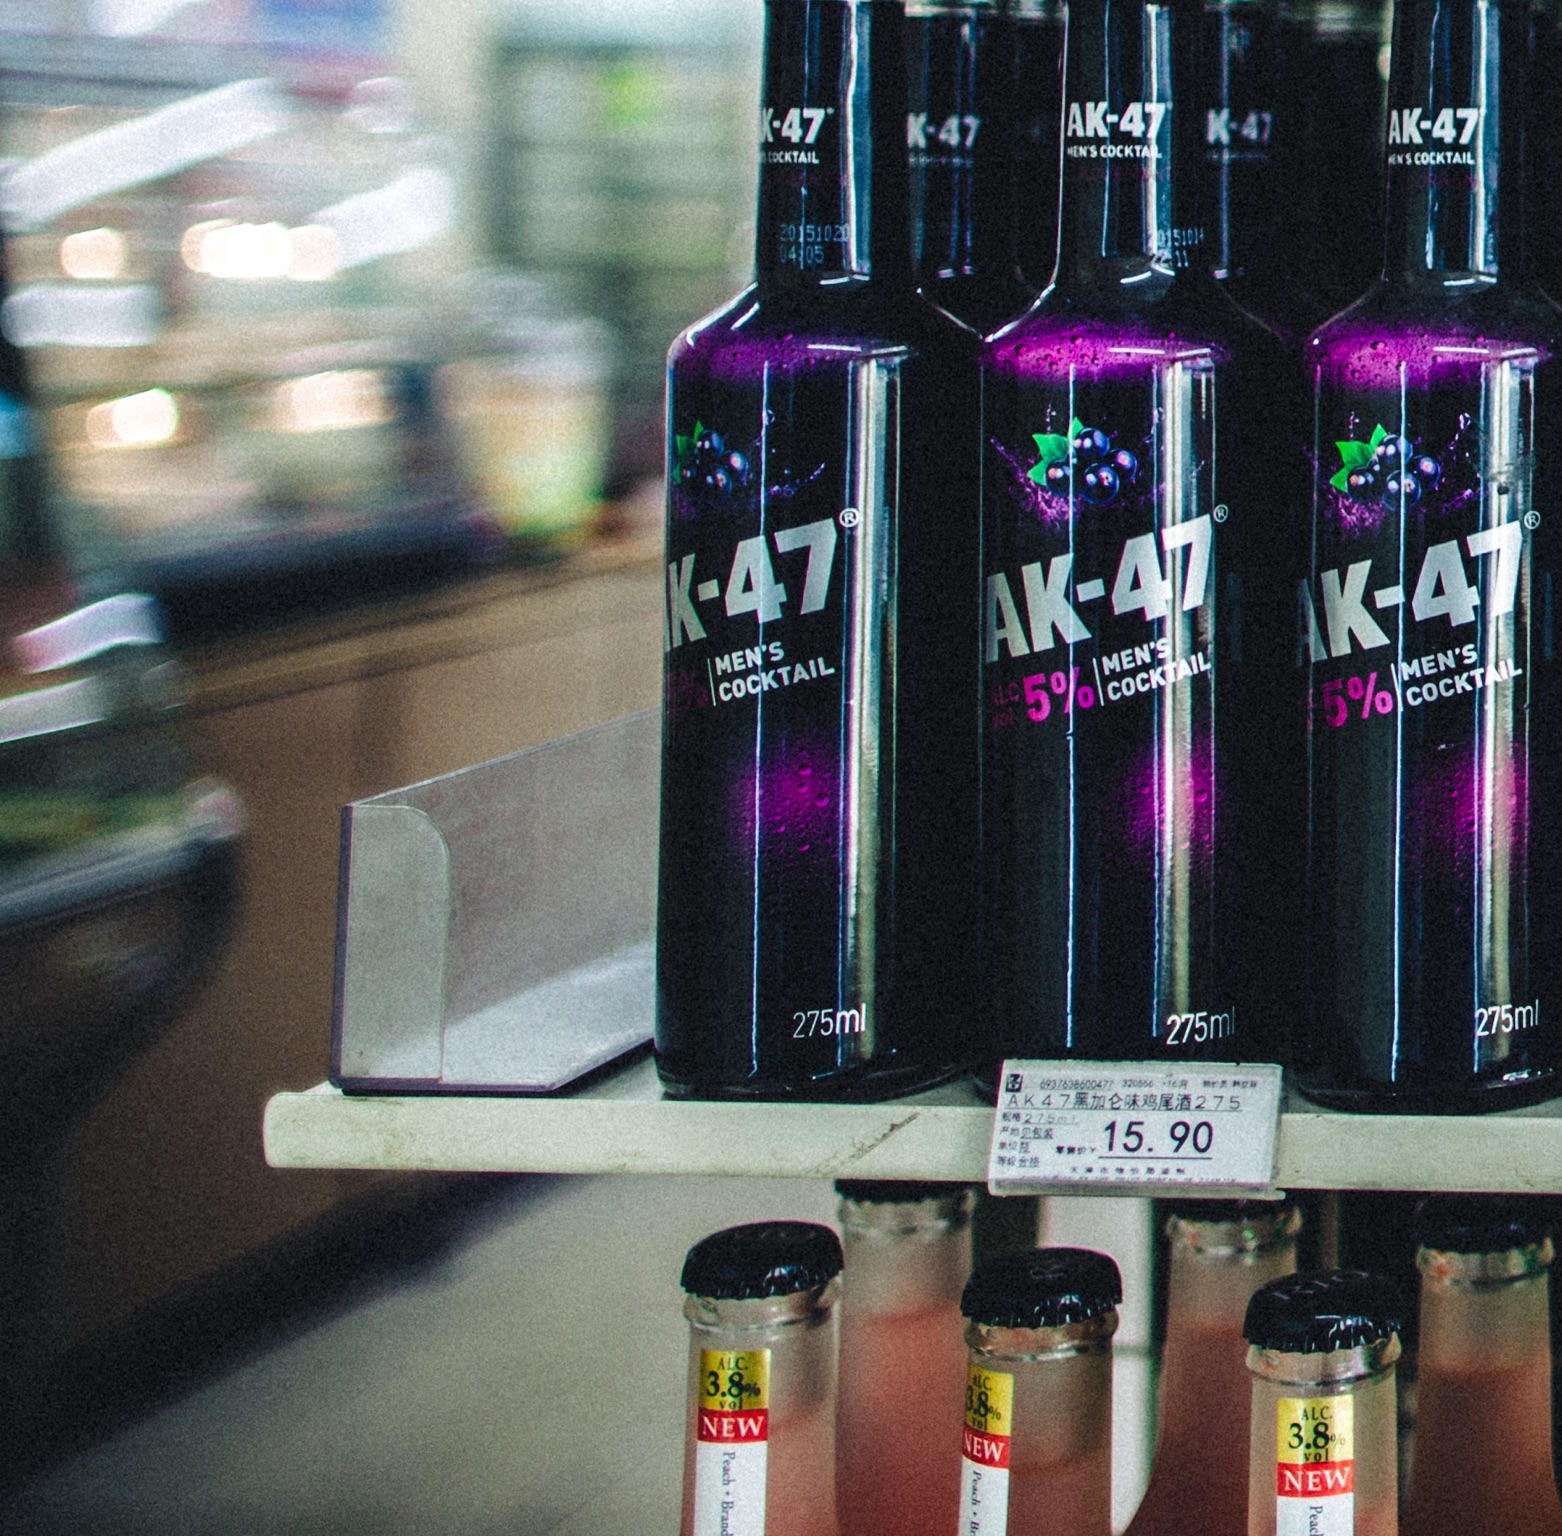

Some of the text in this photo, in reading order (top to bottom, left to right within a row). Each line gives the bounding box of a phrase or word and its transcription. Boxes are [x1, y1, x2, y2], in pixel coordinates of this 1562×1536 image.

[1066, 101, 1166, 139] AK-47
[1388, 107, 1479, 145] AK-47
[1099, 144, 1163, 159] COCKTAIL
[1413, 151, 1476, 166] COCKTAIL
[665, 517, 838, 653] K-47
[985, 513, 1213, 663] AK-47
[714, 641, 785, 677] MEN'S
[1101, 636, 1172, 676] MEN'S
[1401, 643, 1478, 678] MEN'S
[718, 656, 835, 703] COCKTAIL
[1022, 666, 1094, 722] 5%
[1106, 651, 1212, 701] COCKTAIL
[1406, 658, 1523, 707] COCKTAIL
[1322, 671, 1393, 728] 5%
[792, 1002, 866, 1040] 275ml
[1165, 1006, 1236, 1045] 275ml
[1474, 999, 1540, 1037] 275ml
[1104, 1119, 1214, 1154] 15.90
[719, 1397, 743, 1410] vol
[702, 1415, 764, 1438] NEW
[1288, 1421, 1345, 1450] 3.8%
[963, 1434, 1005, 1462] NEW
[1302, 1447, 1329, 1463] vol
[721, 1451, 736, 1486] Peach
[1284, 1466, 1350, 1492] NEW
